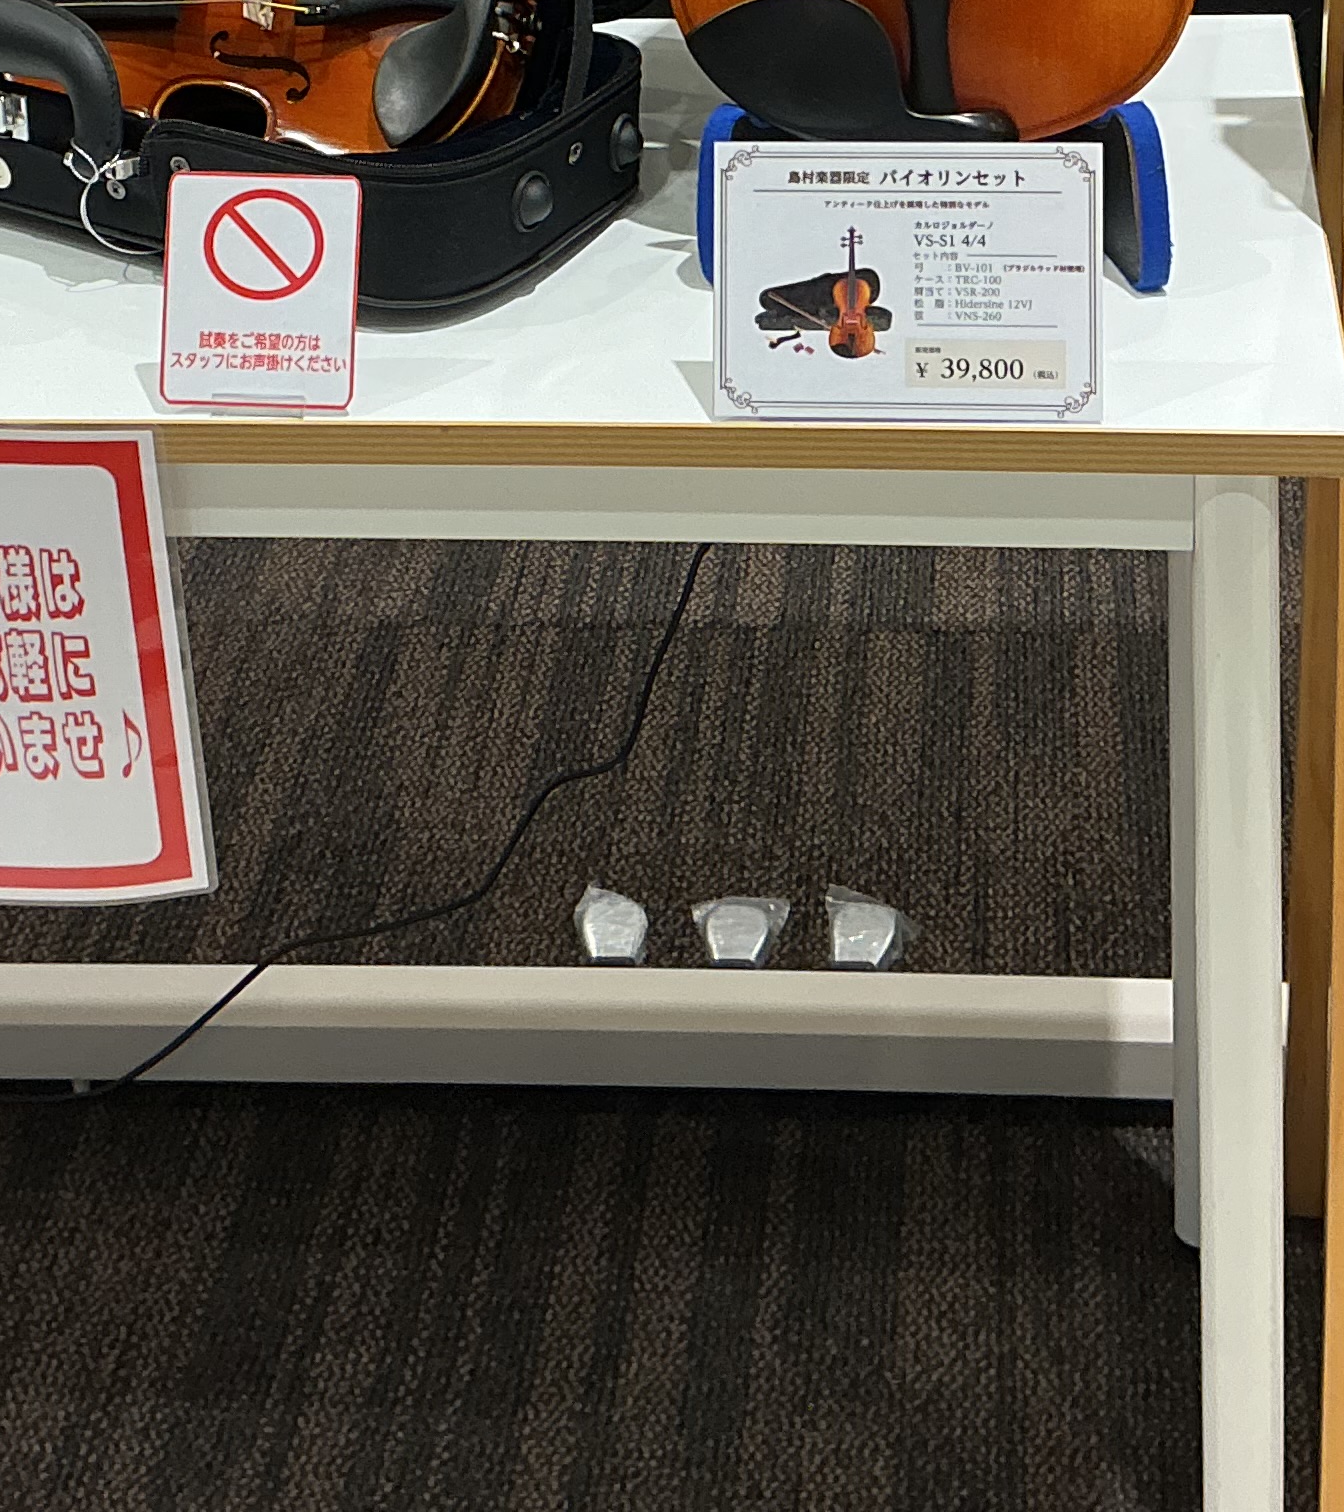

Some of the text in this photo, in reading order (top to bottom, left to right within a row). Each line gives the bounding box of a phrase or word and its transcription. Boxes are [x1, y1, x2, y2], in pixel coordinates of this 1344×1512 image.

[787, 169, 1026, 187] 島村楽器限定 バイオリンセット
[913, 234, 987, 247] VS-S1 4/4
[198, 330, 321, 352] 試奏をご希望の方は
[170, 352, 347, 373] スタッフにお声掛けください
[940, 357, 1025, 382] 39,800
